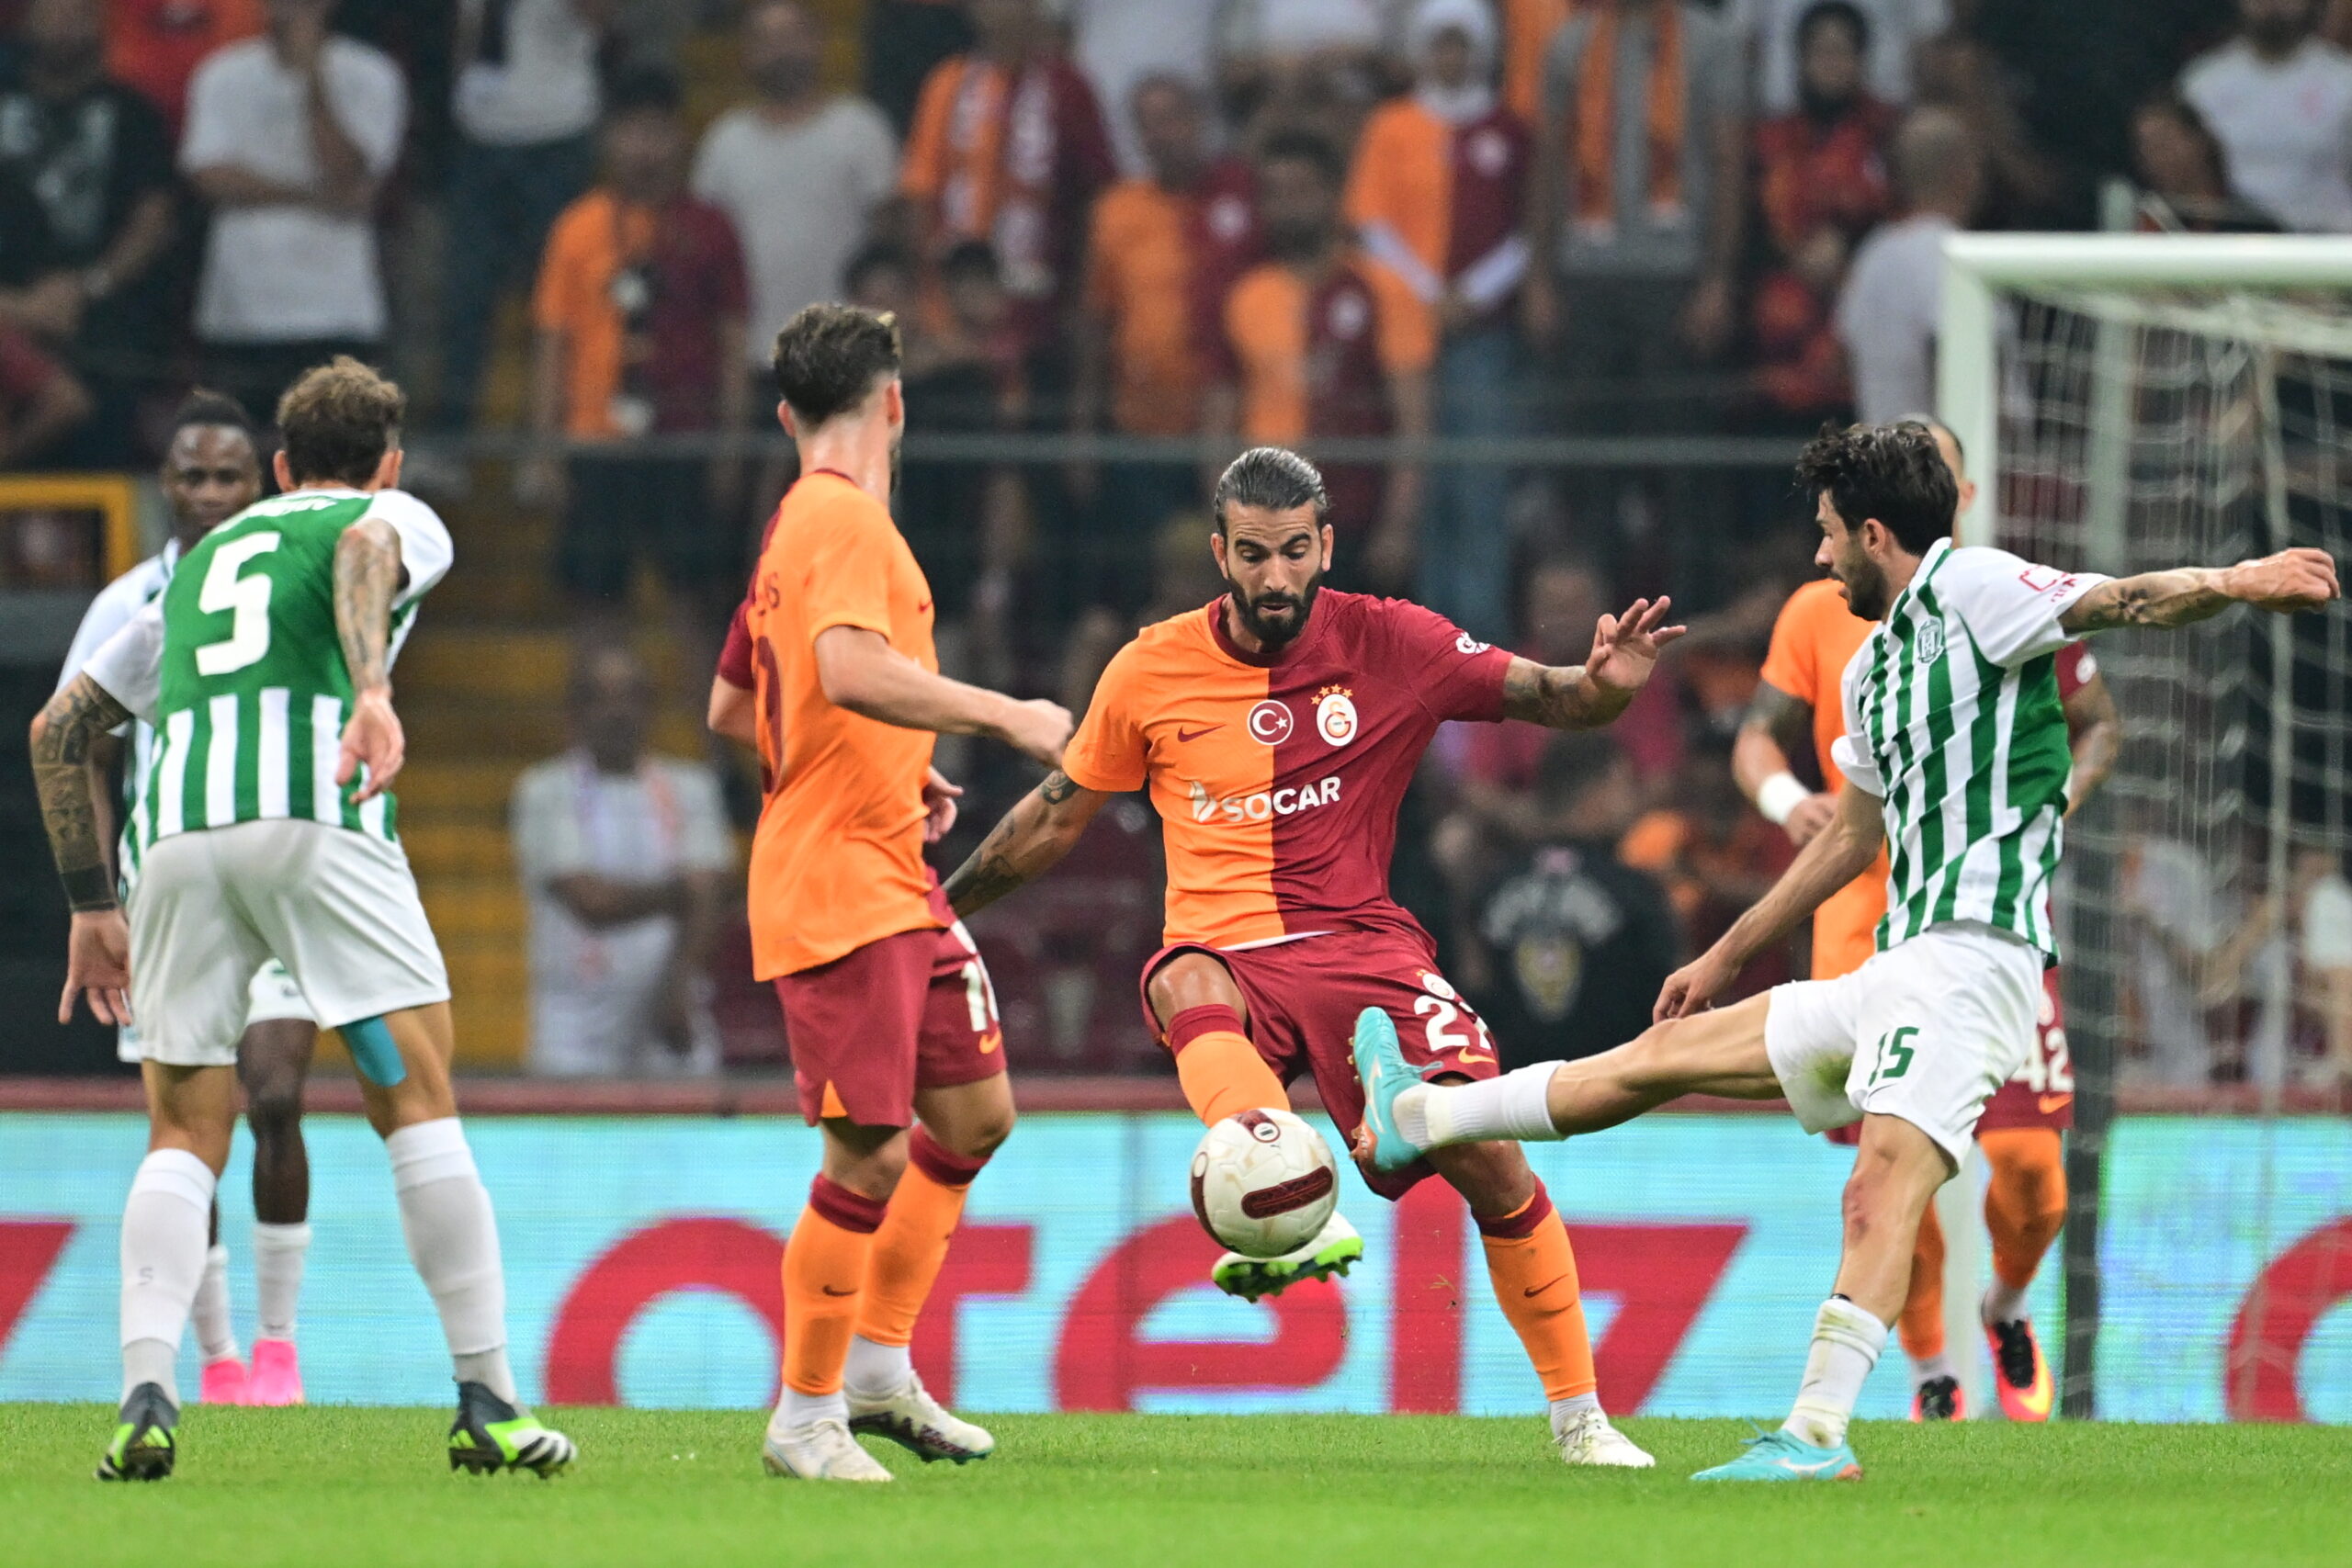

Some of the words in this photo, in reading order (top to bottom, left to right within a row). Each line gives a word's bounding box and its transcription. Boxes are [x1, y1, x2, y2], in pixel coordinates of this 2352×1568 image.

[195, 531, 281, 676] 5
[1221, 776, 1341, 822] SOCAR
[1868, 1026, 1919, 1088] 15
[2010, 1026, 2075, 1093] 42
